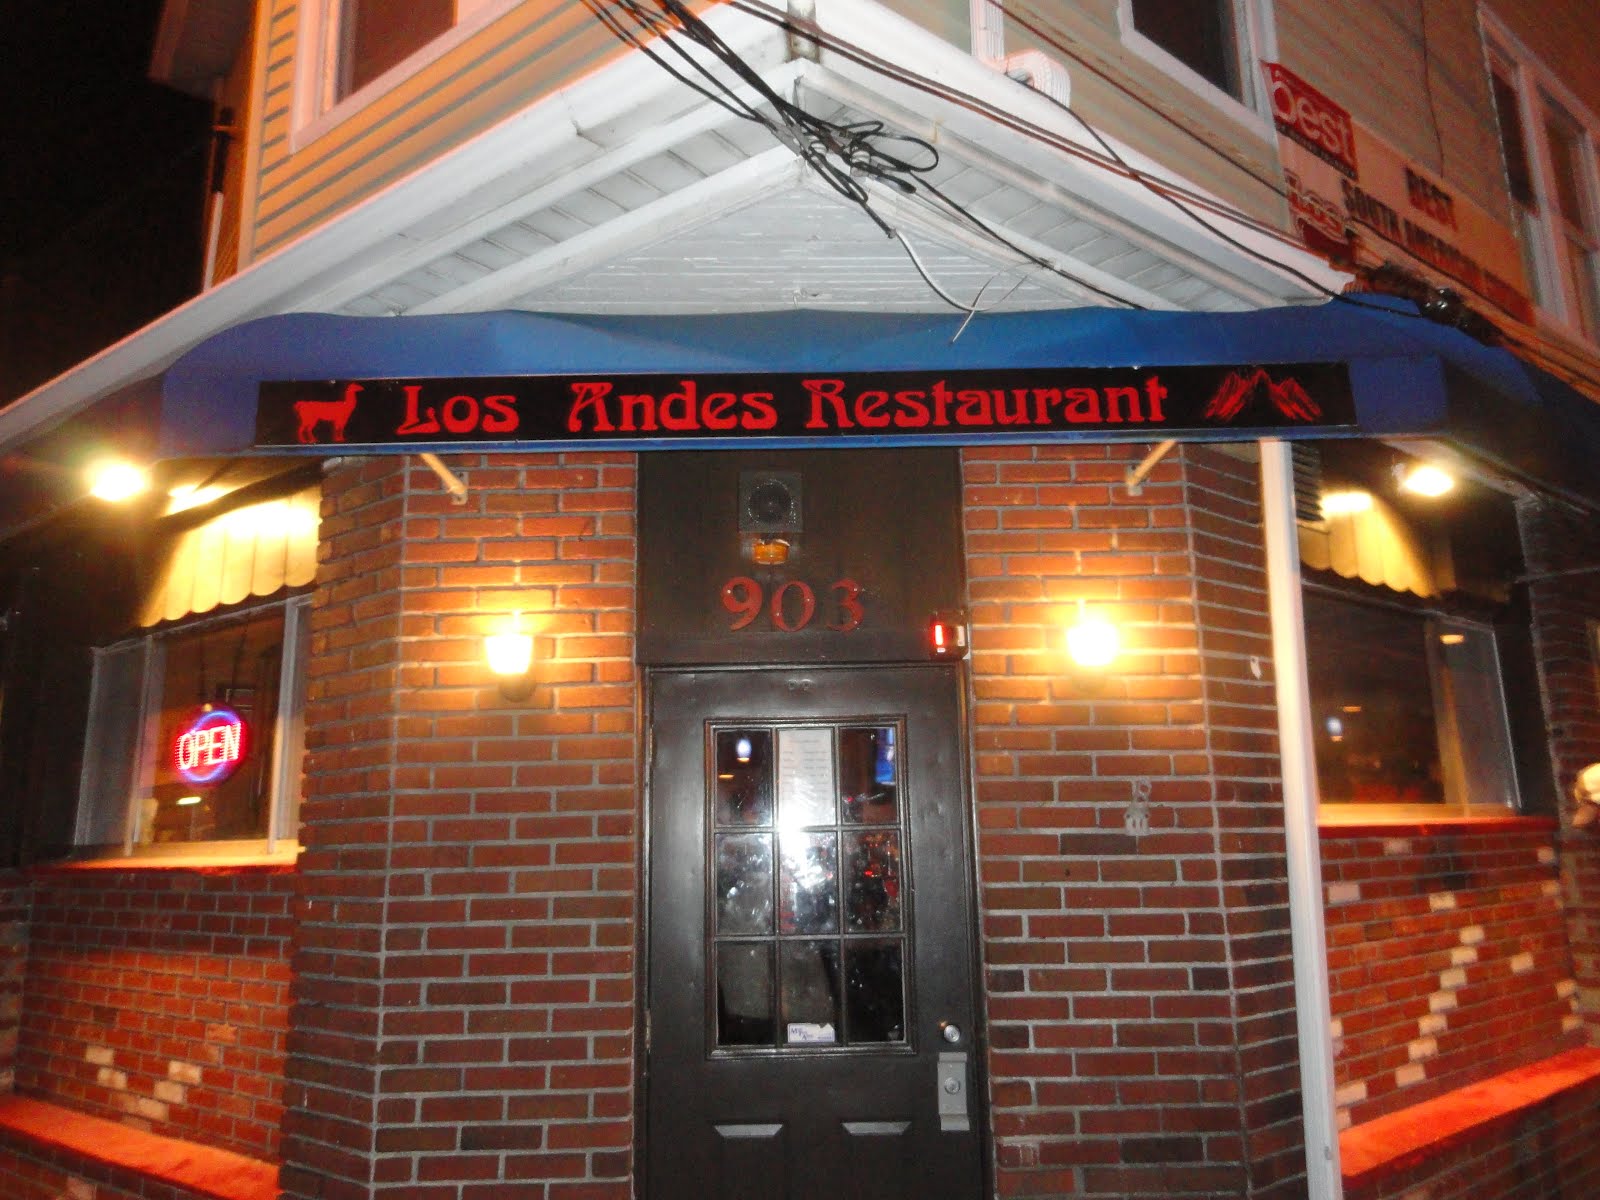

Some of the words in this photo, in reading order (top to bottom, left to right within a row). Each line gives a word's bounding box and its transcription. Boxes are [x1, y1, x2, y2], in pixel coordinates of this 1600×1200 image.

[396, 385, 520, 436] Los
[567, 380, 778, 433] Andes
[802, 375, 1168, 429] Restaurant
[720, 576, 865, 632] 903
[175, 722, 241, 770] OPEN
